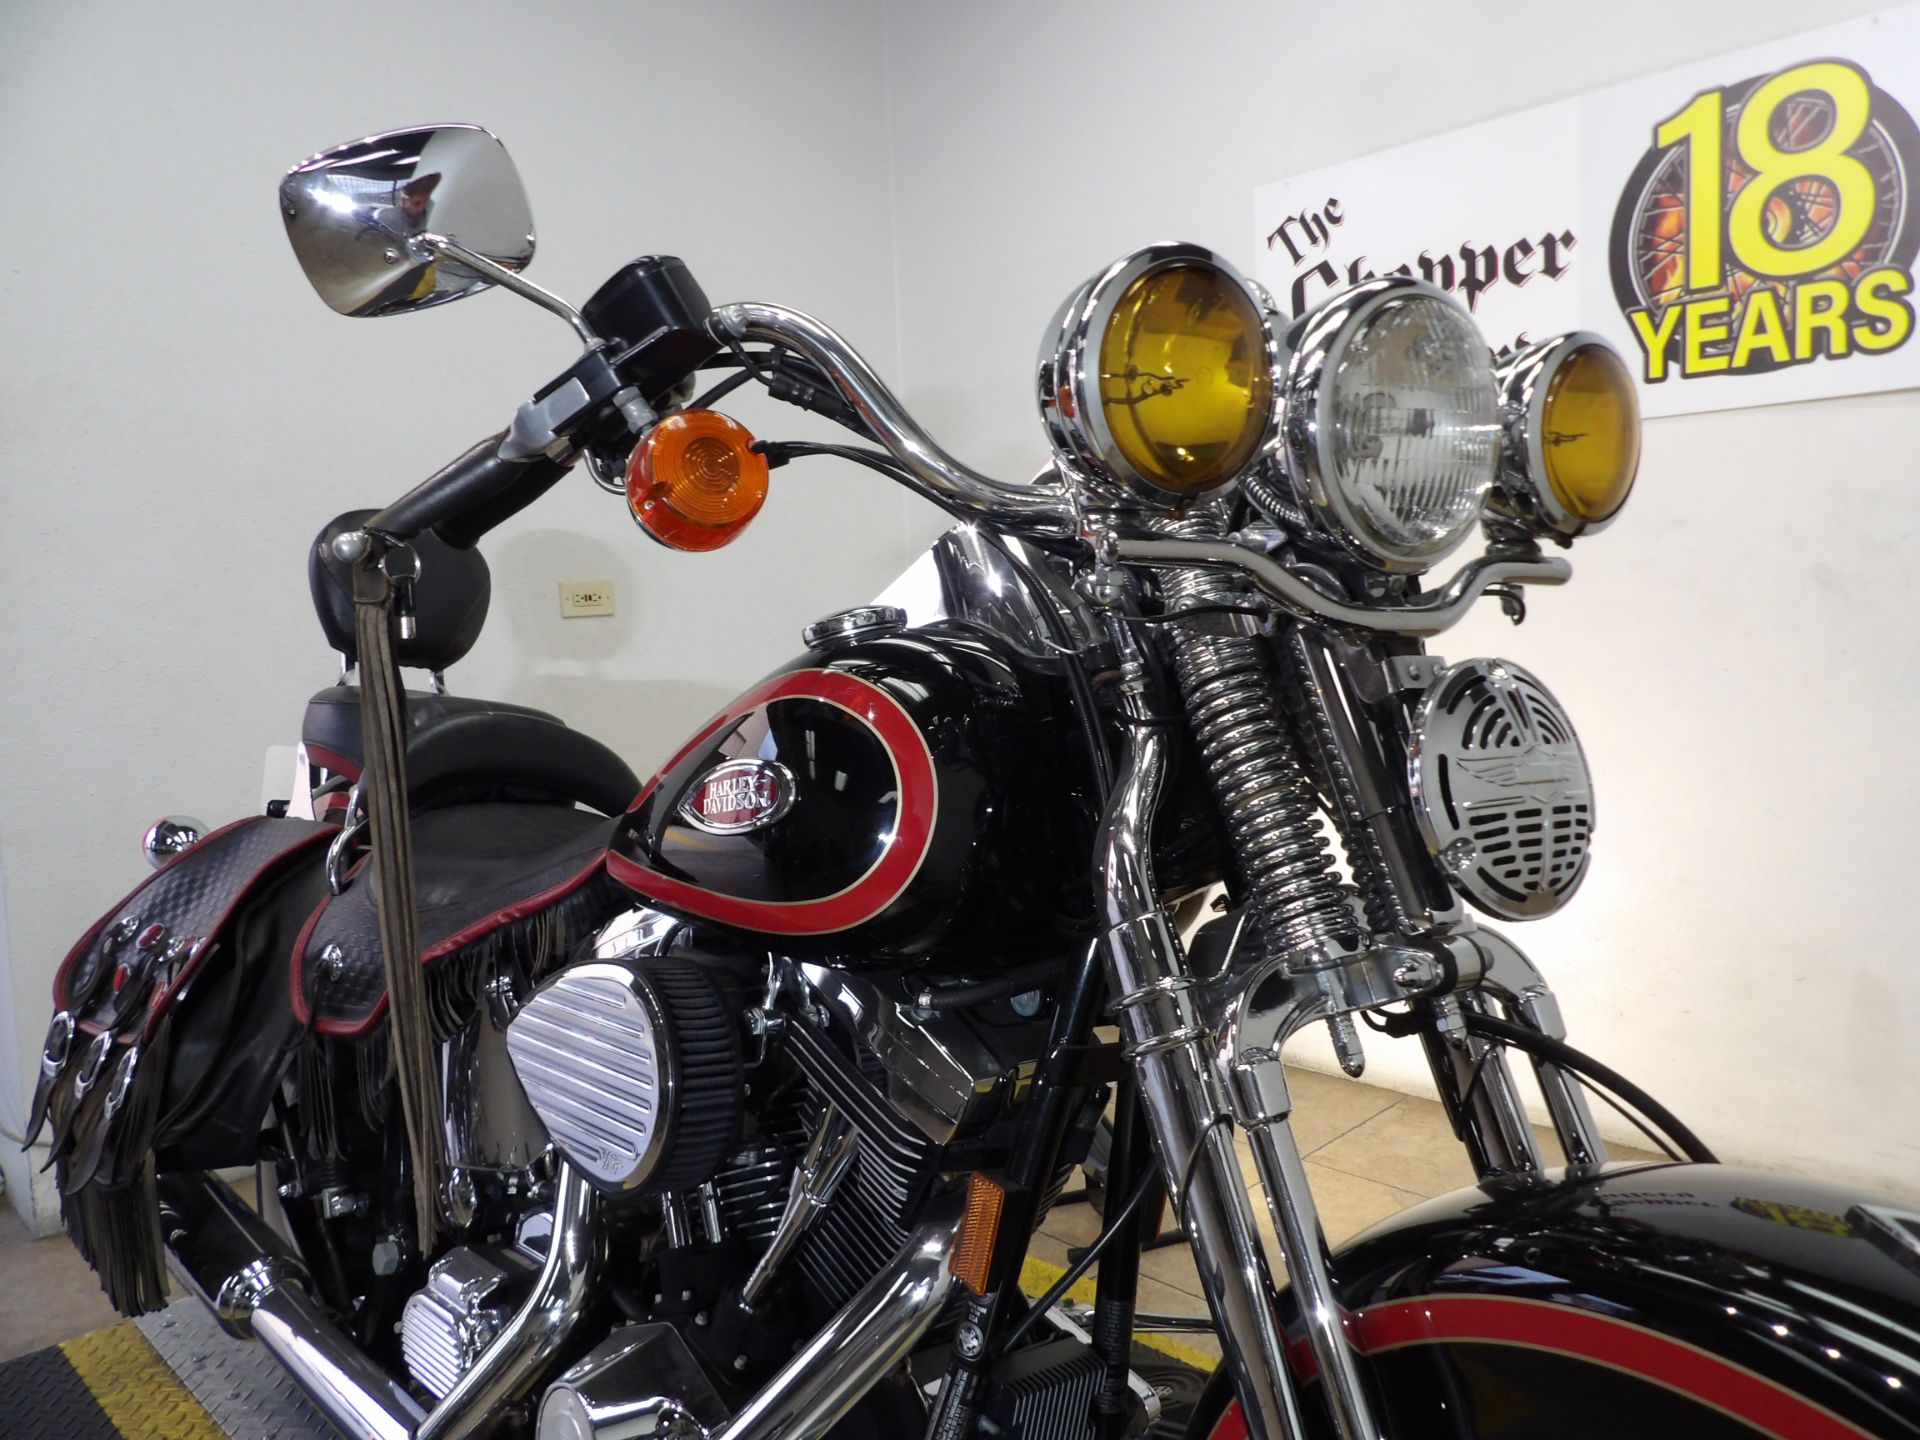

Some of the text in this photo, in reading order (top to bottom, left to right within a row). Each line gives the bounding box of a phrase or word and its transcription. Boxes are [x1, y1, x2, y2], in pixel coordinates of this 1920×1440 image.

[1656, 61, 1876, 291] 18
[1267, 197, 1346, 267] The
[1291, 229, 1578, 321] Cpper
[1630, 268, 1911, 380] YEARS
[703, 791, 769, 815] DAVIDSON
